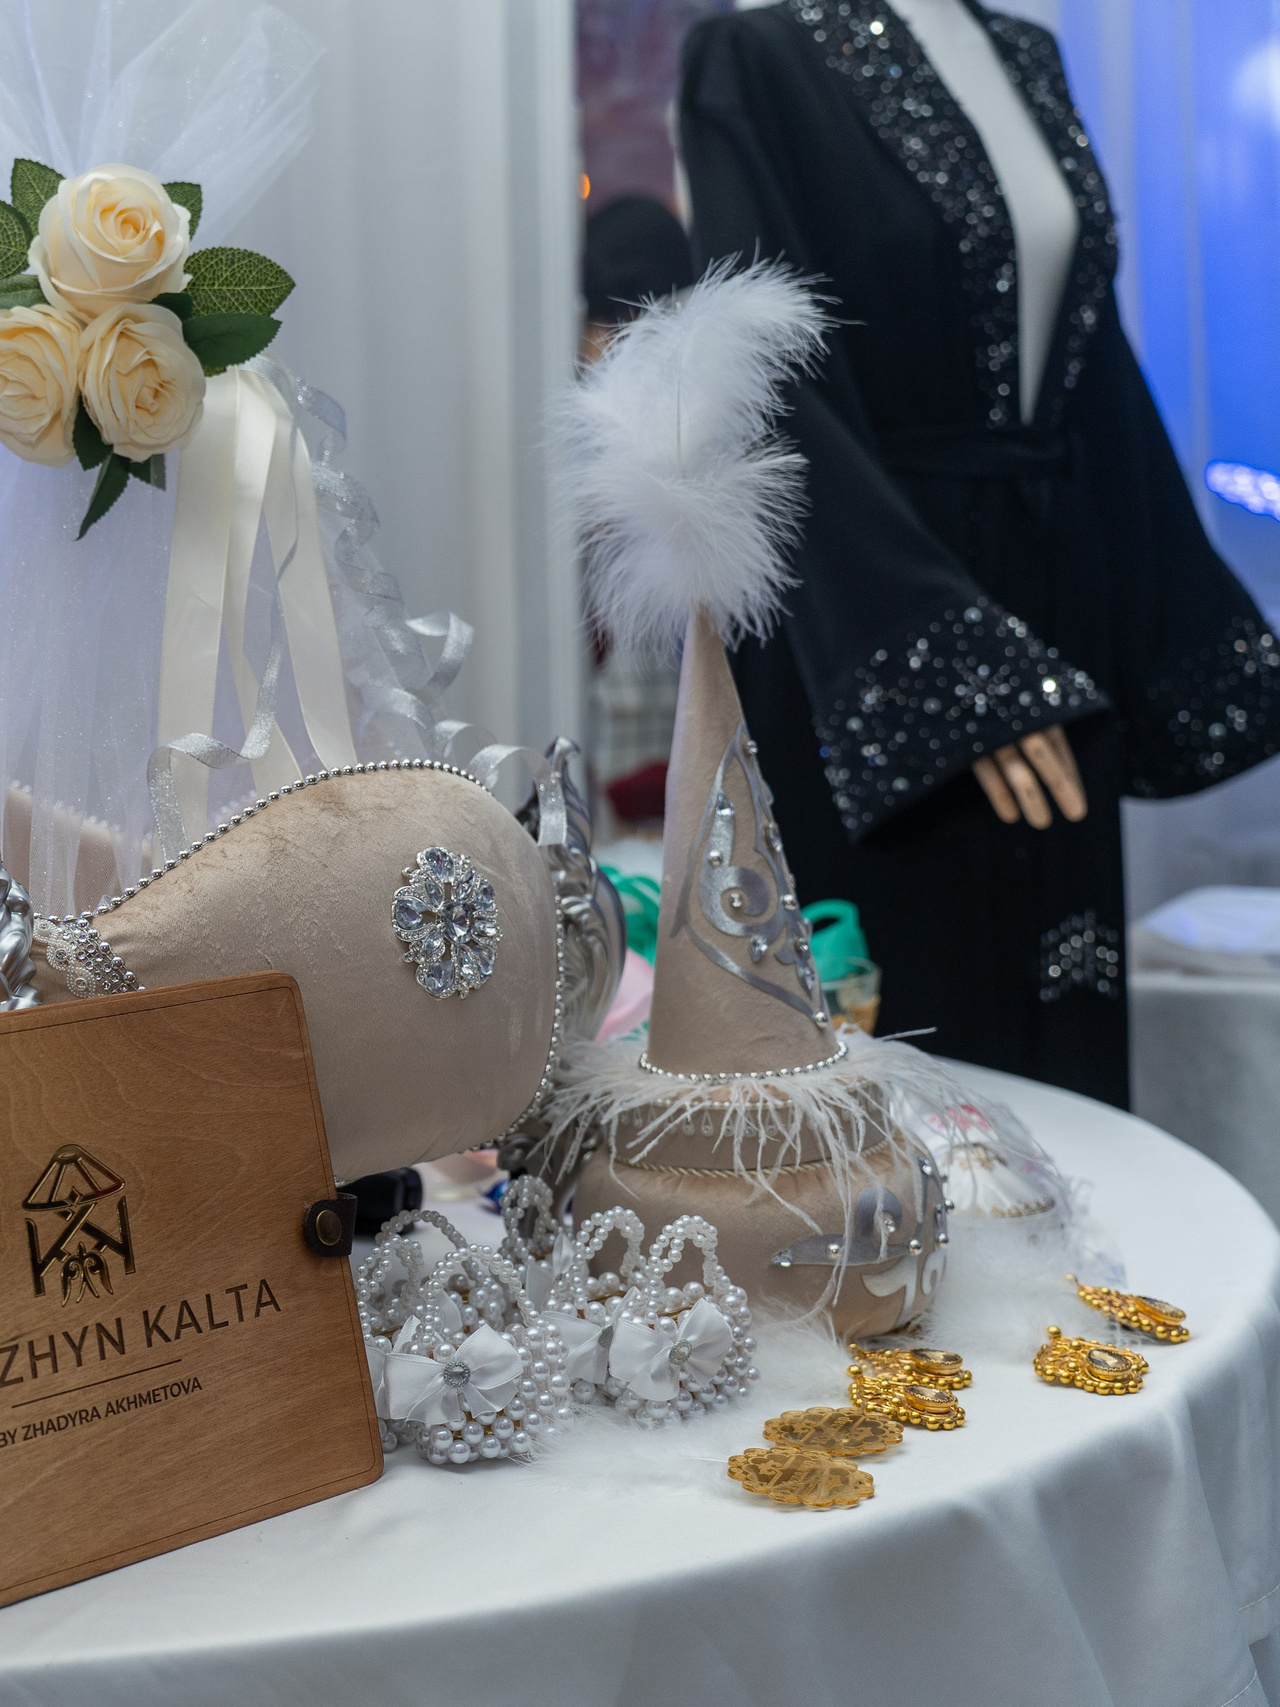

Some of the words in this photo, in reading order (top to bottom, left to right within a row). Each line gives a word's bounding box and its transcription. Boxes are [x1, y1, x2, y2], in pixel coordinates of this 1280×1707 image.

[143, 1279, 281, 1348] KALTA
[21, 1406, 101, 1441] ZHADYRA
[105, 1377, 202, 1417] AKHMETOVA
